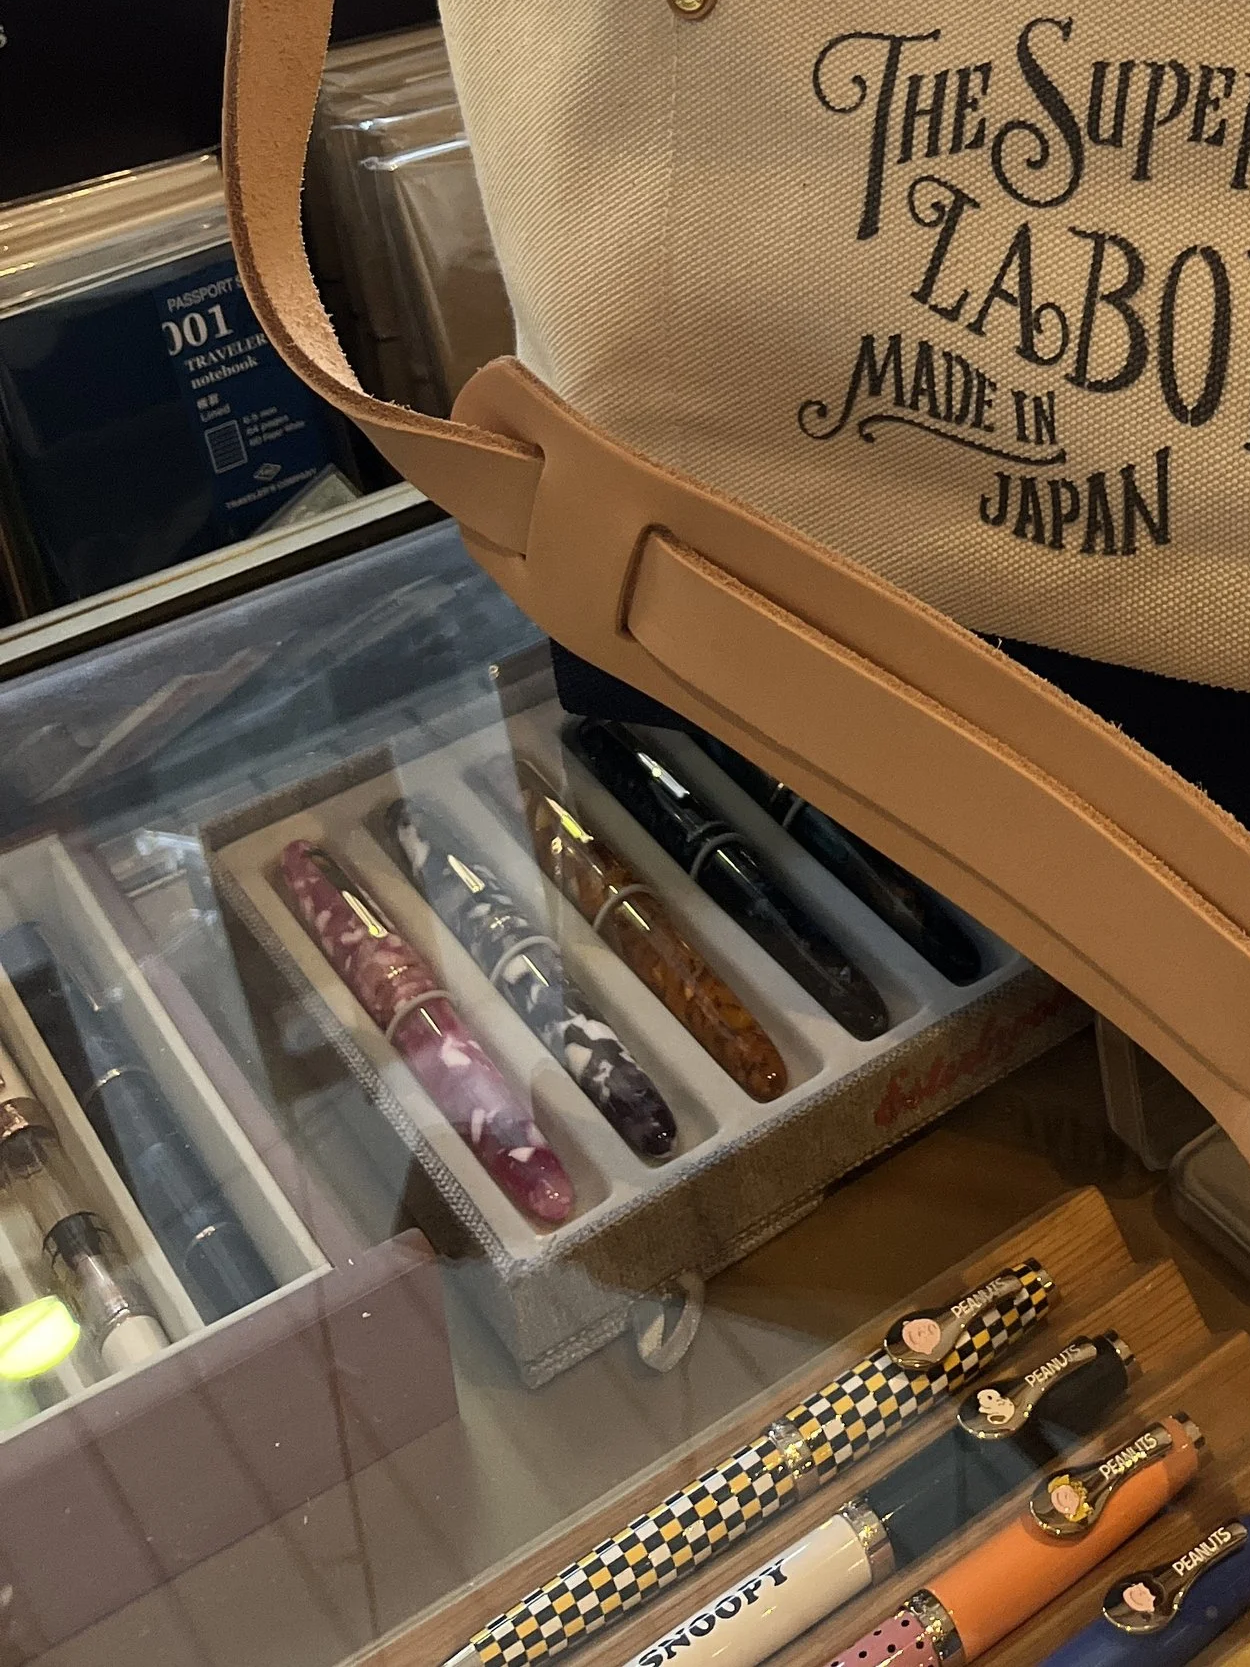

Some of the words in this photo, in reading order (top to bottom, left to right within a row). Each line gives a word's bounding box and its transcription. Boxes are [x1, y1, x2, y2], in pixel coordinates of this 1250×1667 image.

[813, 28, 992, 241] THE
[166, 276, 234, 313] PASSPORT
[184, 332, 269, 372] TRAVELER
[190, 354, 259, 390] notebook
[798, 333, 997, 440] MADE
[1011, 389, 1058, 446] IN
[979, 445, 1172, 556] JAPAN
[951, 1277, 1007, 1319] PEANUTS
[1024, 1344, 1082, 1388] PEANUTS
[1099, 1432, 1158, 1481] PEANUTS
[1172, 1526, 1233, 1577] PEANUTS
[632, 1558, 788, 1667] SNOOPY
